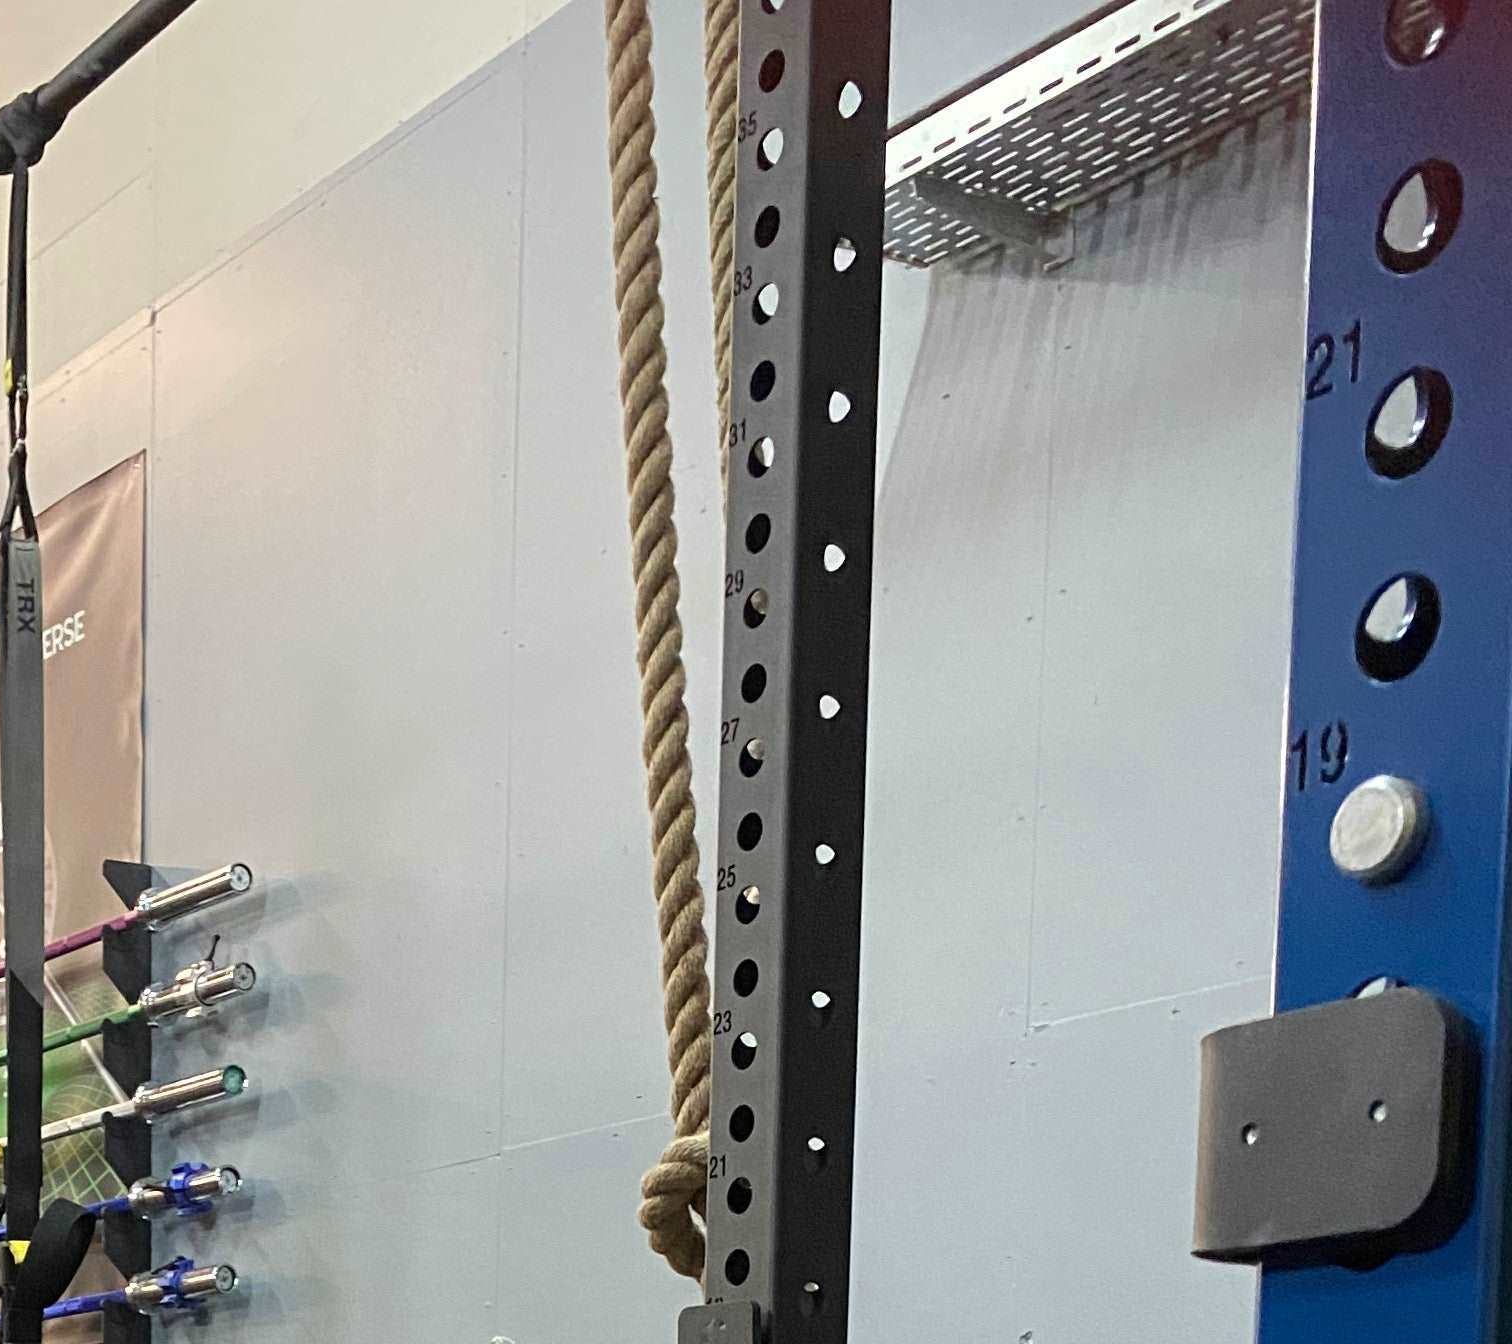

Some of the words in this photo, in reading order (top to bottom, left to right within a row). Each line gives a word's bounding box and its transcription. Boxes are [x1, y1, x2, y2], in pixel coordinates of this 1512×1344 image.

[733, 265, 753, 297] 33
[1305, 320, 1362, 400] 21
[729, 418, 748, 449] 31
[724, 568, 744, 598] 29
[16, 577, 37, 634] TRX
[42, 610, 86, 660] ERSE
[720, 718, 740, 747] 27
[1287, 718, 1351, 794] 19
[717, 865, 737, 891] 25
[713, 1012, 732, 1037] 23
[709, 1156, 728, 1180] 21
